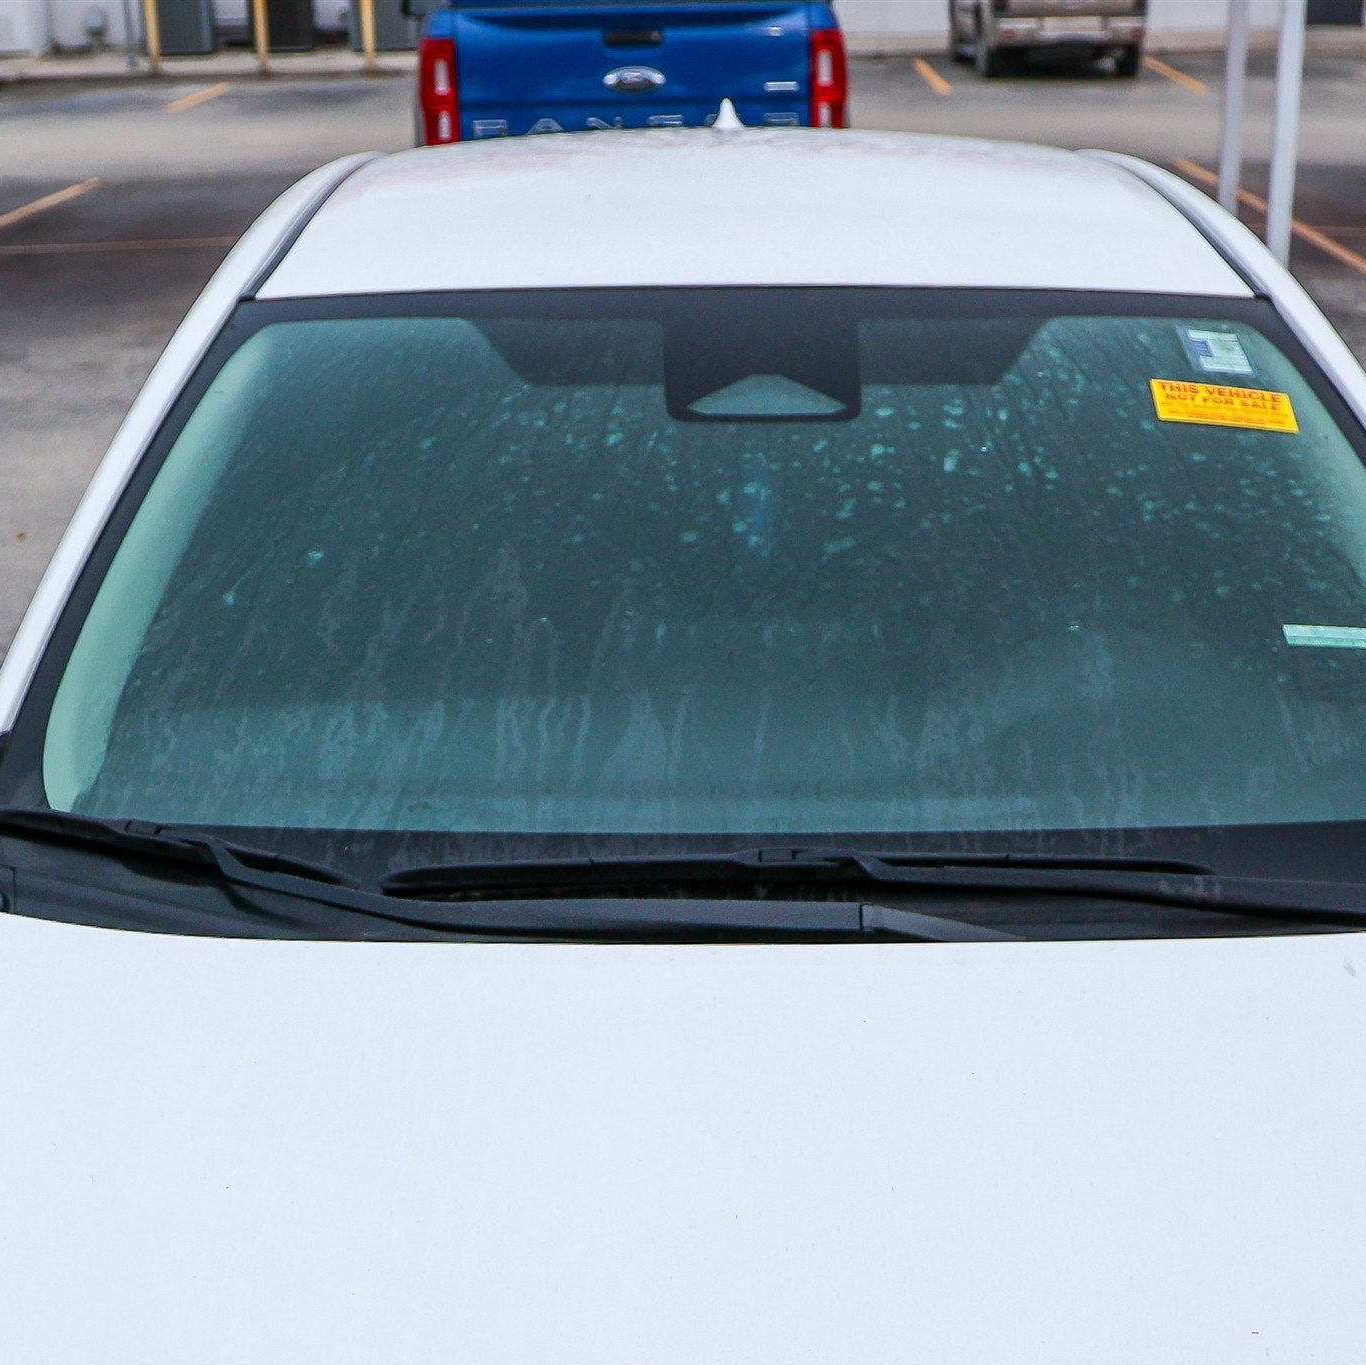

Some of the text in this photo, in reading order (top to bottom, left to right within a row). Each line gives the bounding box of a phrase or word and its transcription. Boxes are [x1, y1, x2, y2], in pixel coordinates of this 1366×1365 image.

[1160, 382, 1282, 402] THIS VEHICLE
[1166, 393, 1281, 411] NOT FOR SALE
